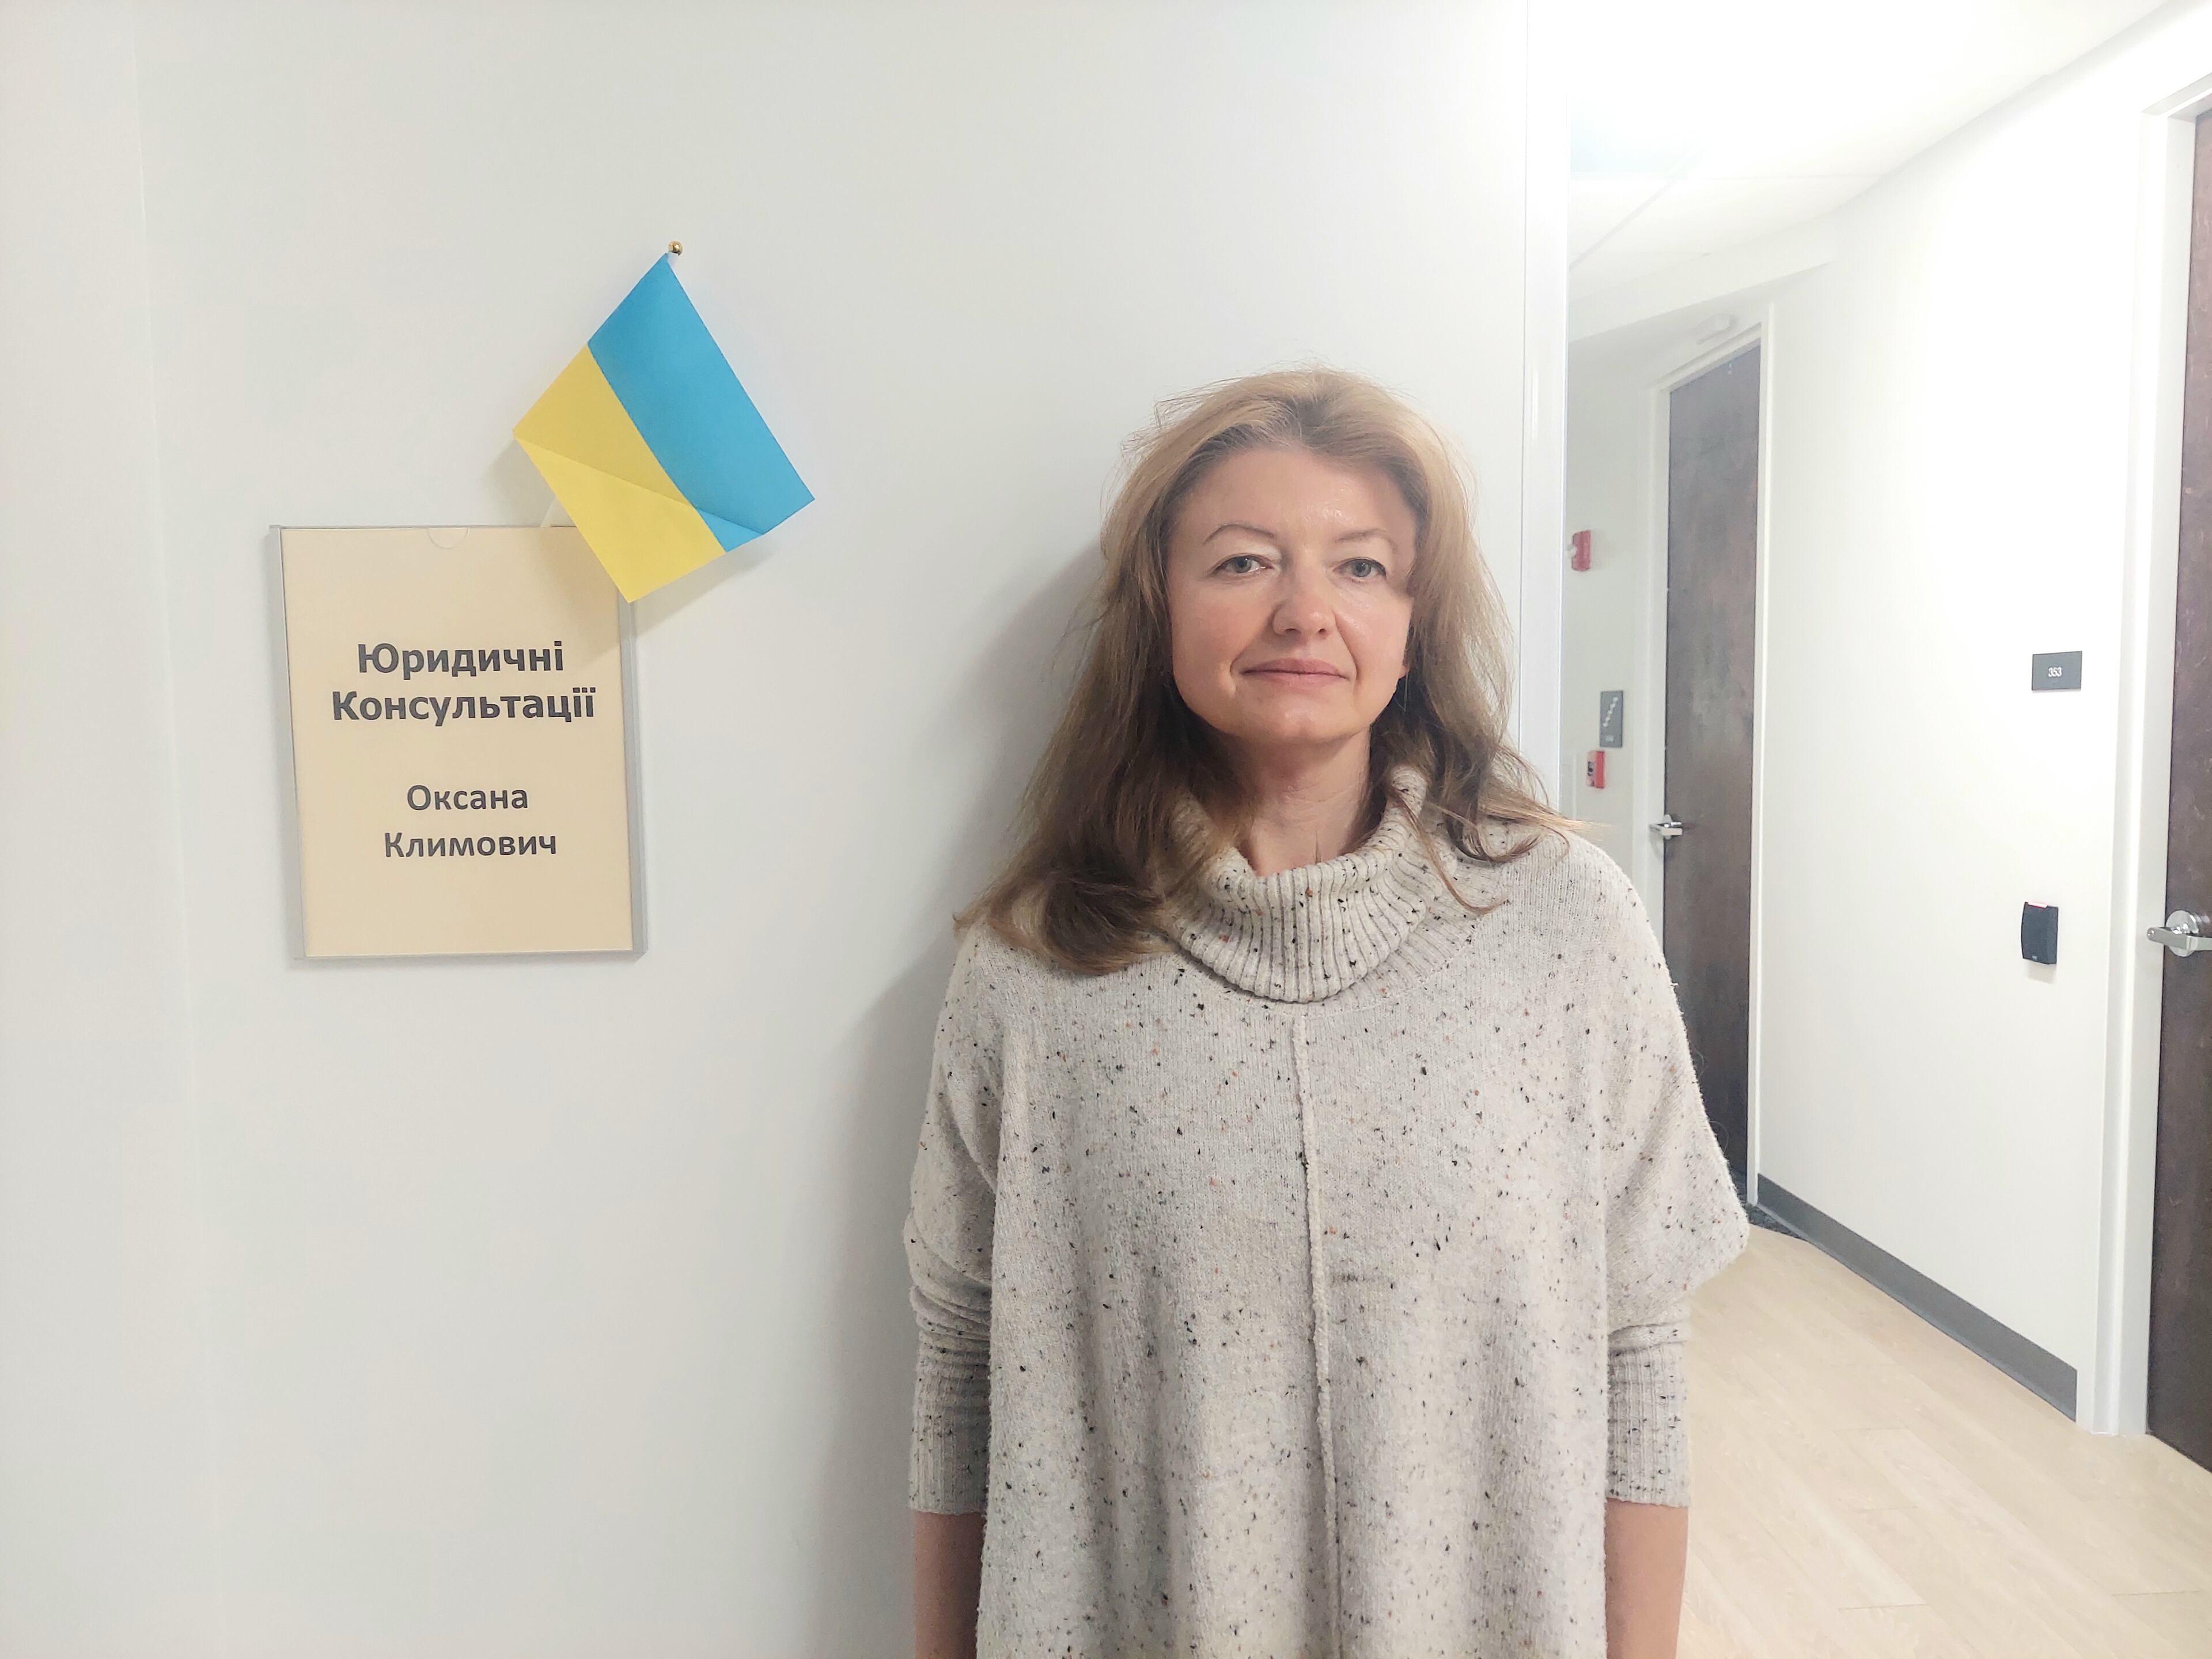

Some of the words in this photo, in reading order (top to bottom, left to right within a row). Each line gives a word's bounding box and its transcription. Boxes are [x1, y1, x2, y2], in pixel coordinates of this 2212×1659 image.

[358, 640, 563, 680] Юридичні
[2048, 666, 2062, 677] 353
[332, 687, 596, 727] Консультації
[407, 785, 528, 811] Оксана
[384, 832, 556, 858] Климович
